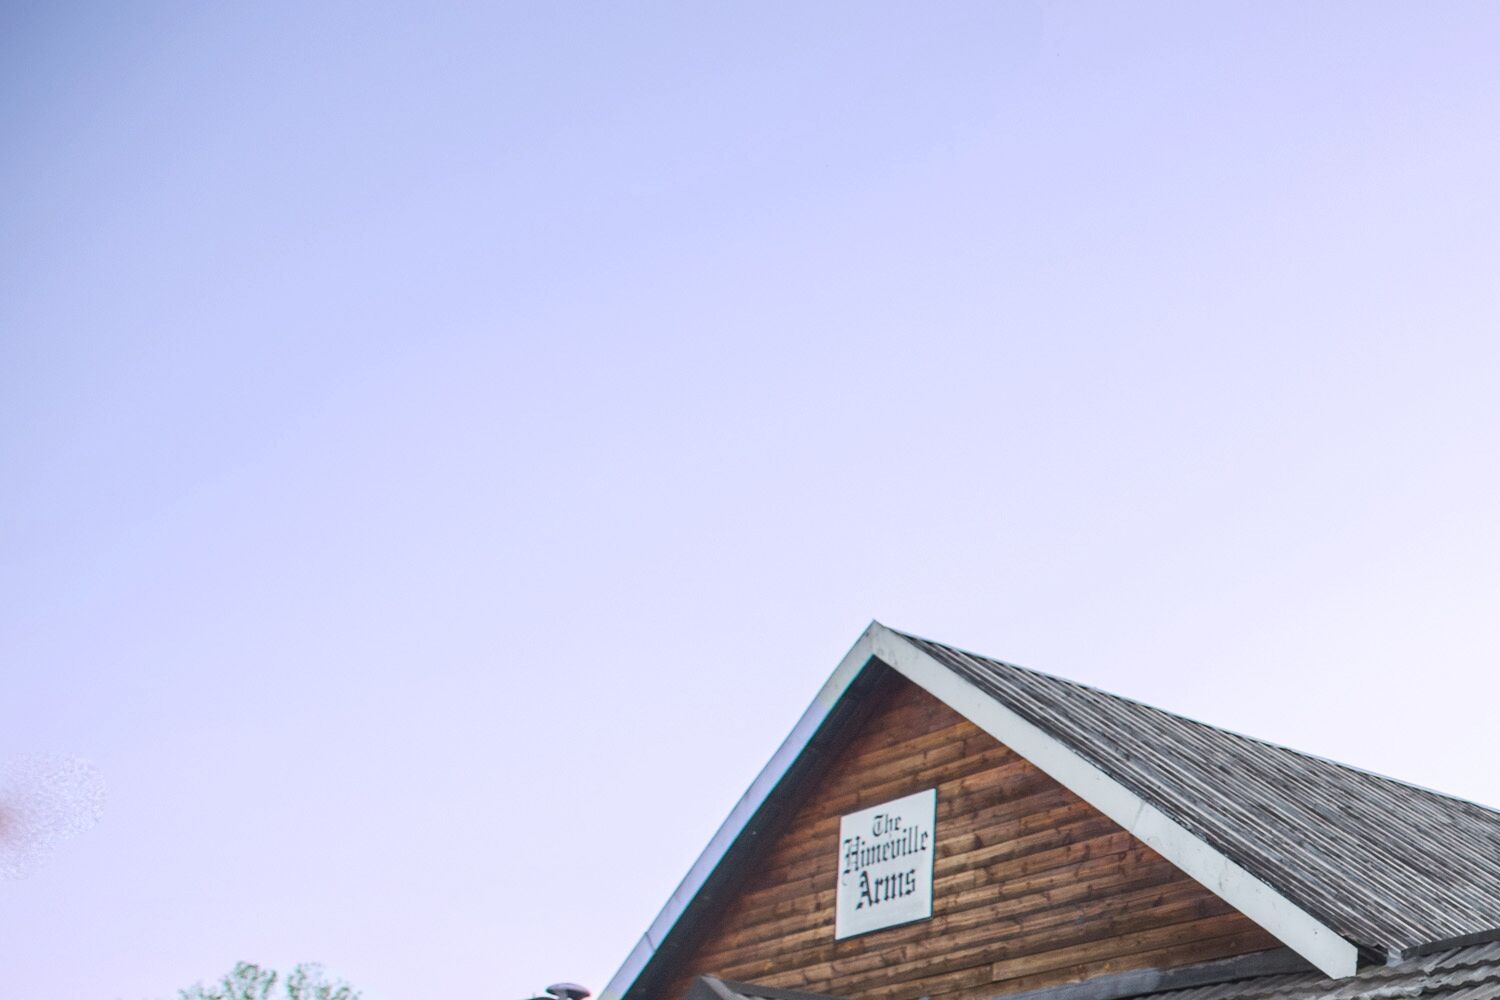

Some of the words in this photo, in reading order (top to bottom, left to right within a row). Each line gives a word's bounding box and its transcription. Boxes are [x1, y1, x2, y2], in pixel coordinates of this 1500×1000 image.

[872, 812, 902, 838] The
[842, 825, 929, 886] Himeville
[856, 869, 916, 910] Arms
